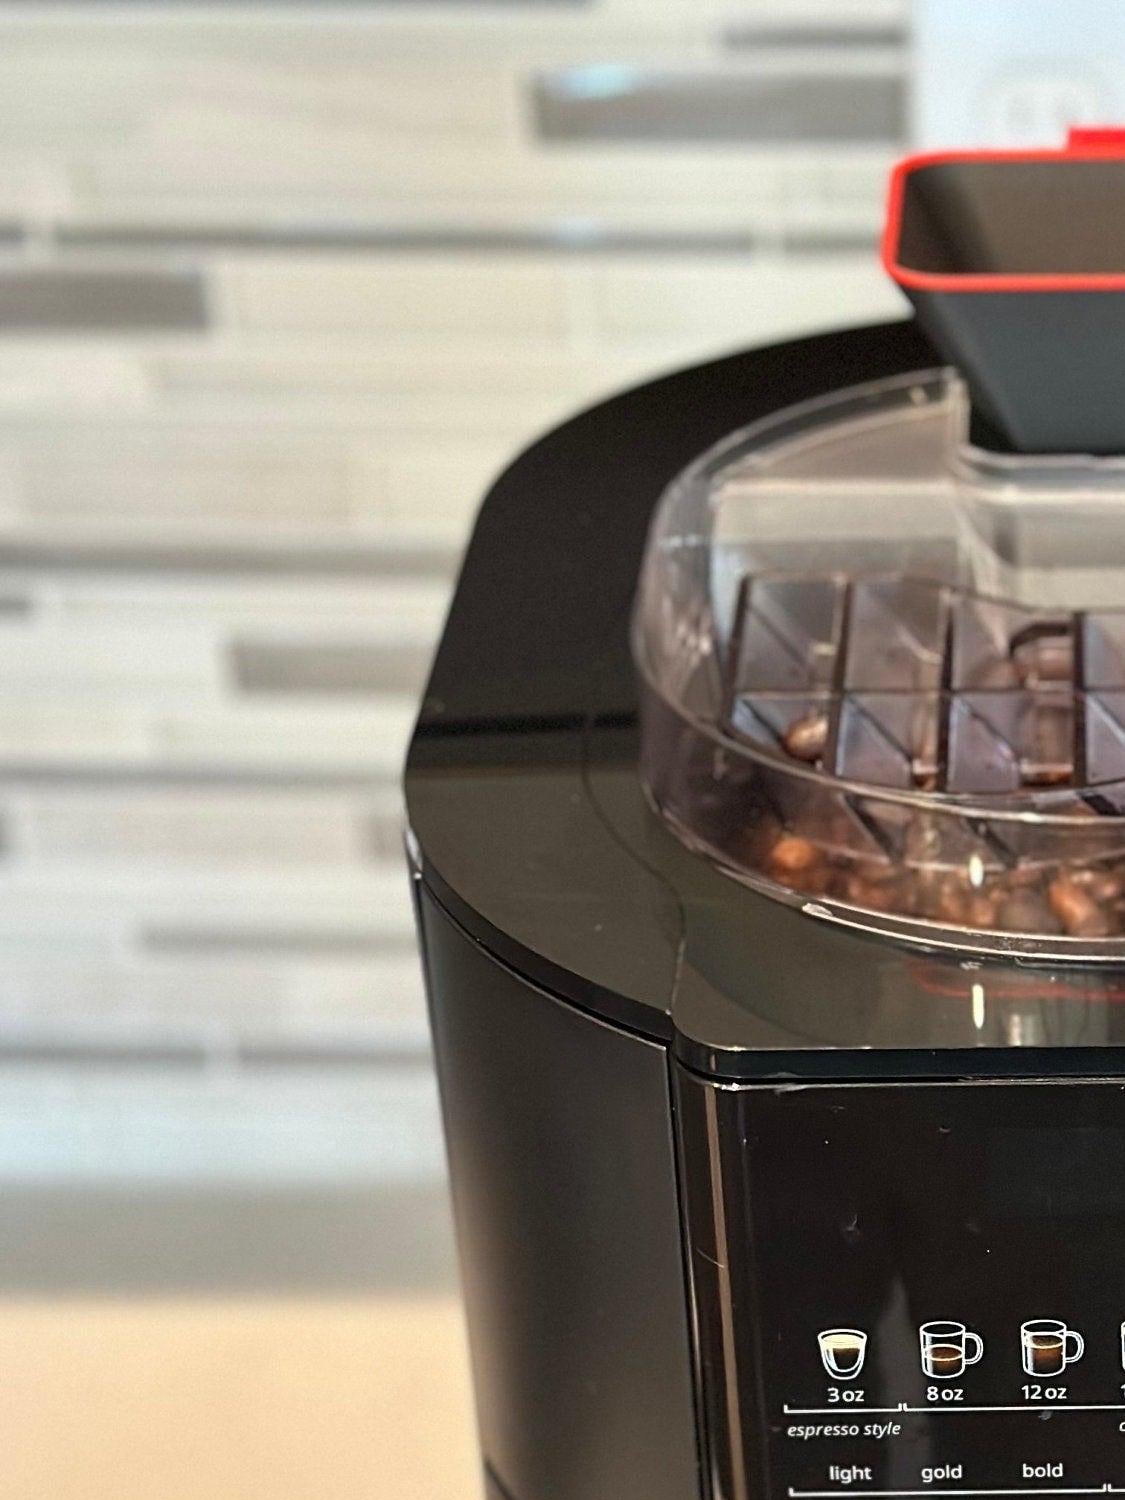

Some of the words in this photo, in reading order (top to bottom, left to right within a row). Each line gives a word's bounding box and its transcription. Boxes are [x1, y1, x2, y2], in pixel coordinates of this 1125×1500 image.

[827, 1386, 840, 1403] 3
[841, 1390, 865, 1403] oz
[926, 1385, 939, 1401] 8
[941, 1388, 964, 1401] oz
[1021, 1384, 1042, 1400] 12
[1044, 1387, 1068, 1400] oz
[787, 1424, 860, 1440] espresso
[863, 1421, 902, 1439] style
[829, 1465, 873, 1484] light
[921, 1464, 963, 1483] gold
[1022, 1462, 1064, 1478] bold
